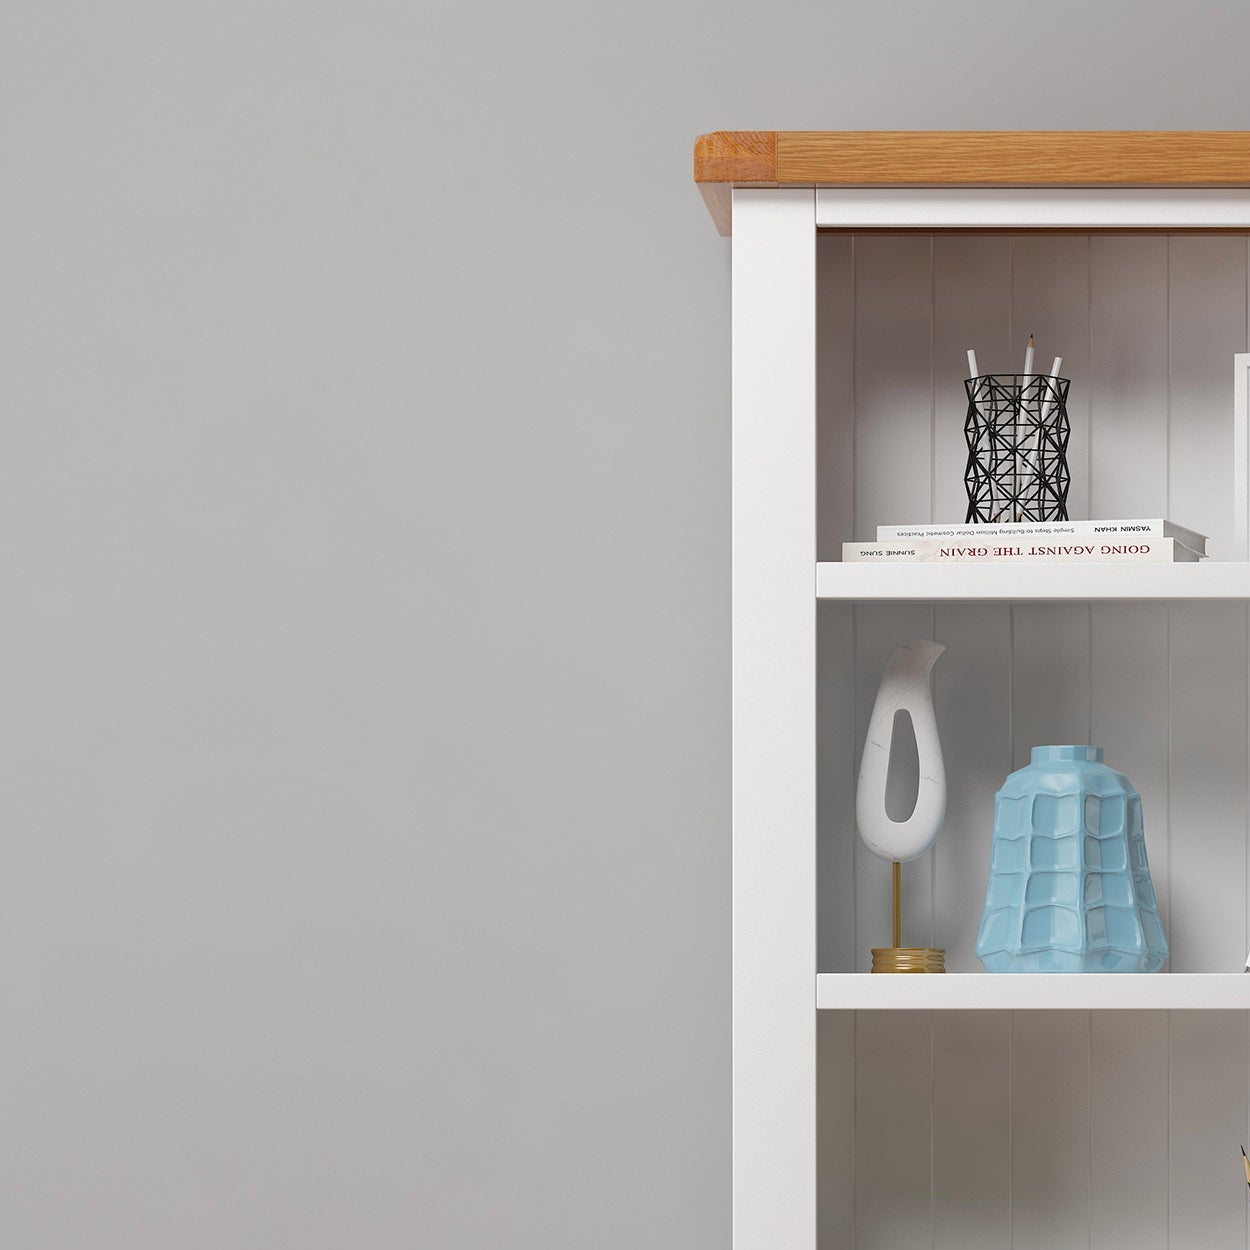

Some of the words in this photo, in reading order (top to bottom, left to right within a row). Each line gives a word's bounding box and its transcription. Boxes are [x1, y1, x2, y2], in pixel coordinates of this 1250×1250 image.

[940, 548, 988, 557] GRAIN
[993, 547, 1024, 556] THE
[1028, 546, 1095, 555] AGAINST
[1101, 545, 1150, 555] GOING
